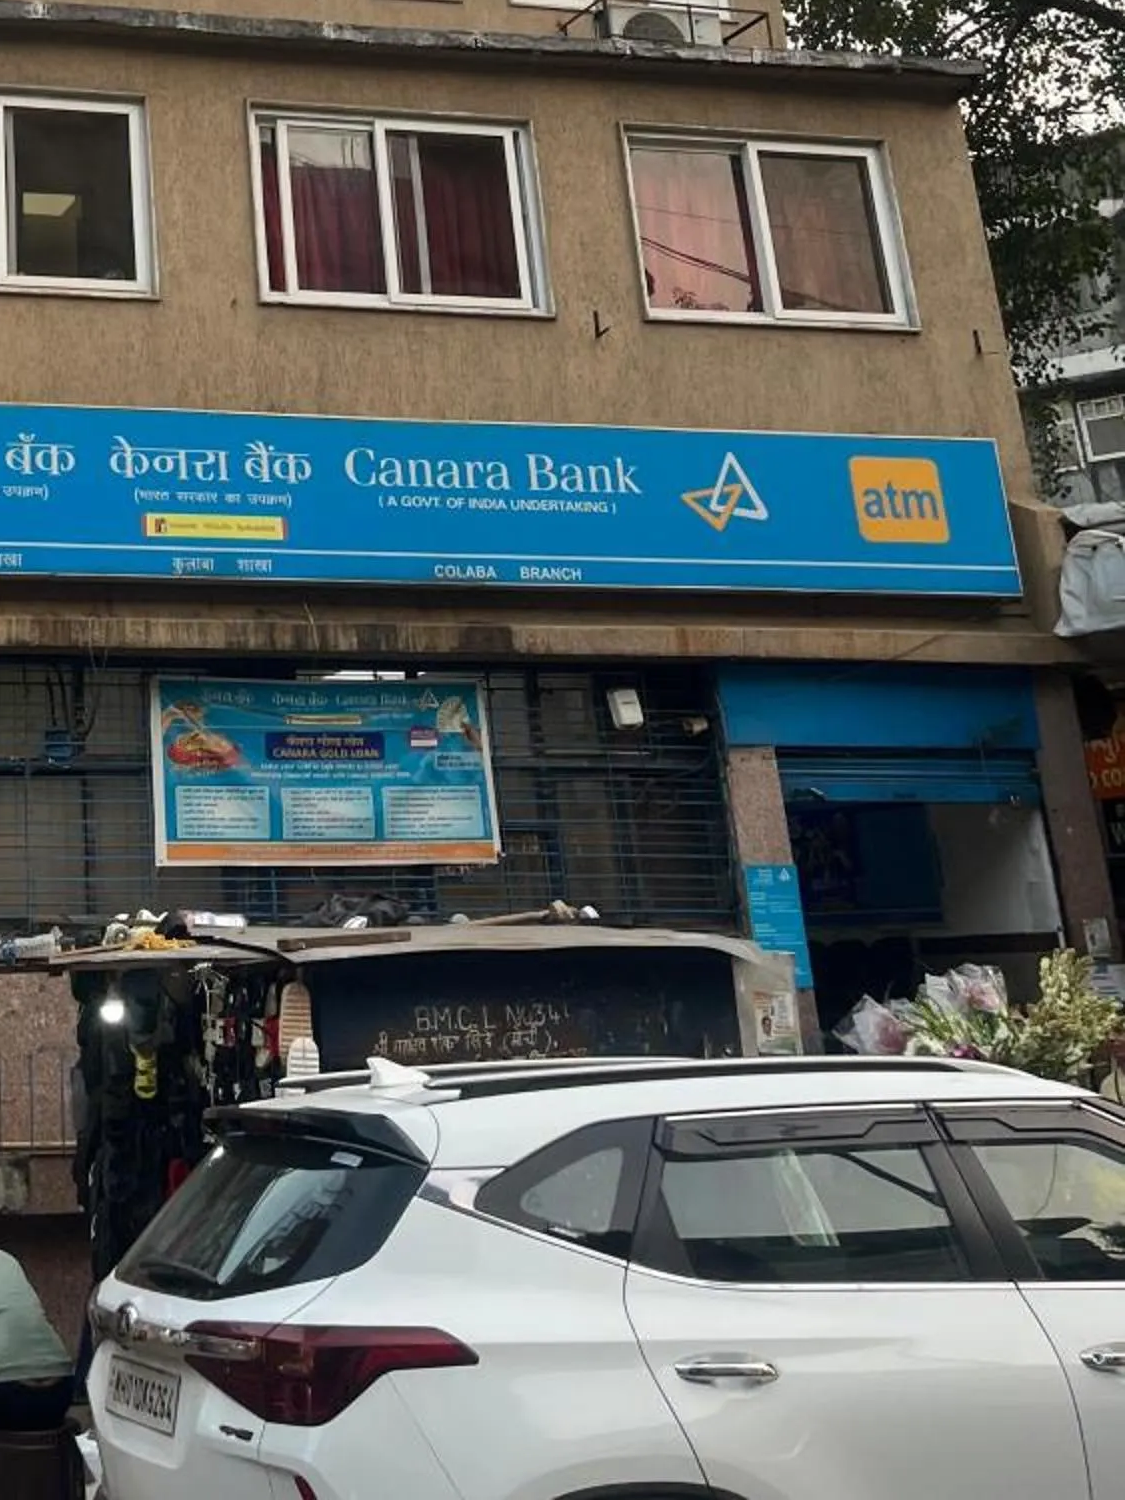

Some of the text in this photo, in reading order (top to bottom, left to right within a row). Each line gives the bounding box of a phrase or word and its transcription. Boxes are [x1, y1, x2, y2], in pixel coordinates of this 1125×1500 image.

[5, 432, 76, 477] बँक
[109, 435, 313, 485] केनरा बैंक
[344, 446, 643, 495] Canara Bank
[446, 497, 467, 509] OF
[468, 497, 507, 511] INDIA
[510, 499, 609, 514] UNDERTAKING
[862, 480, 940, 521] atm
[236, 557, 273, 574] शाखा
[434, 564, 583, 582] COLABA BRANCH
